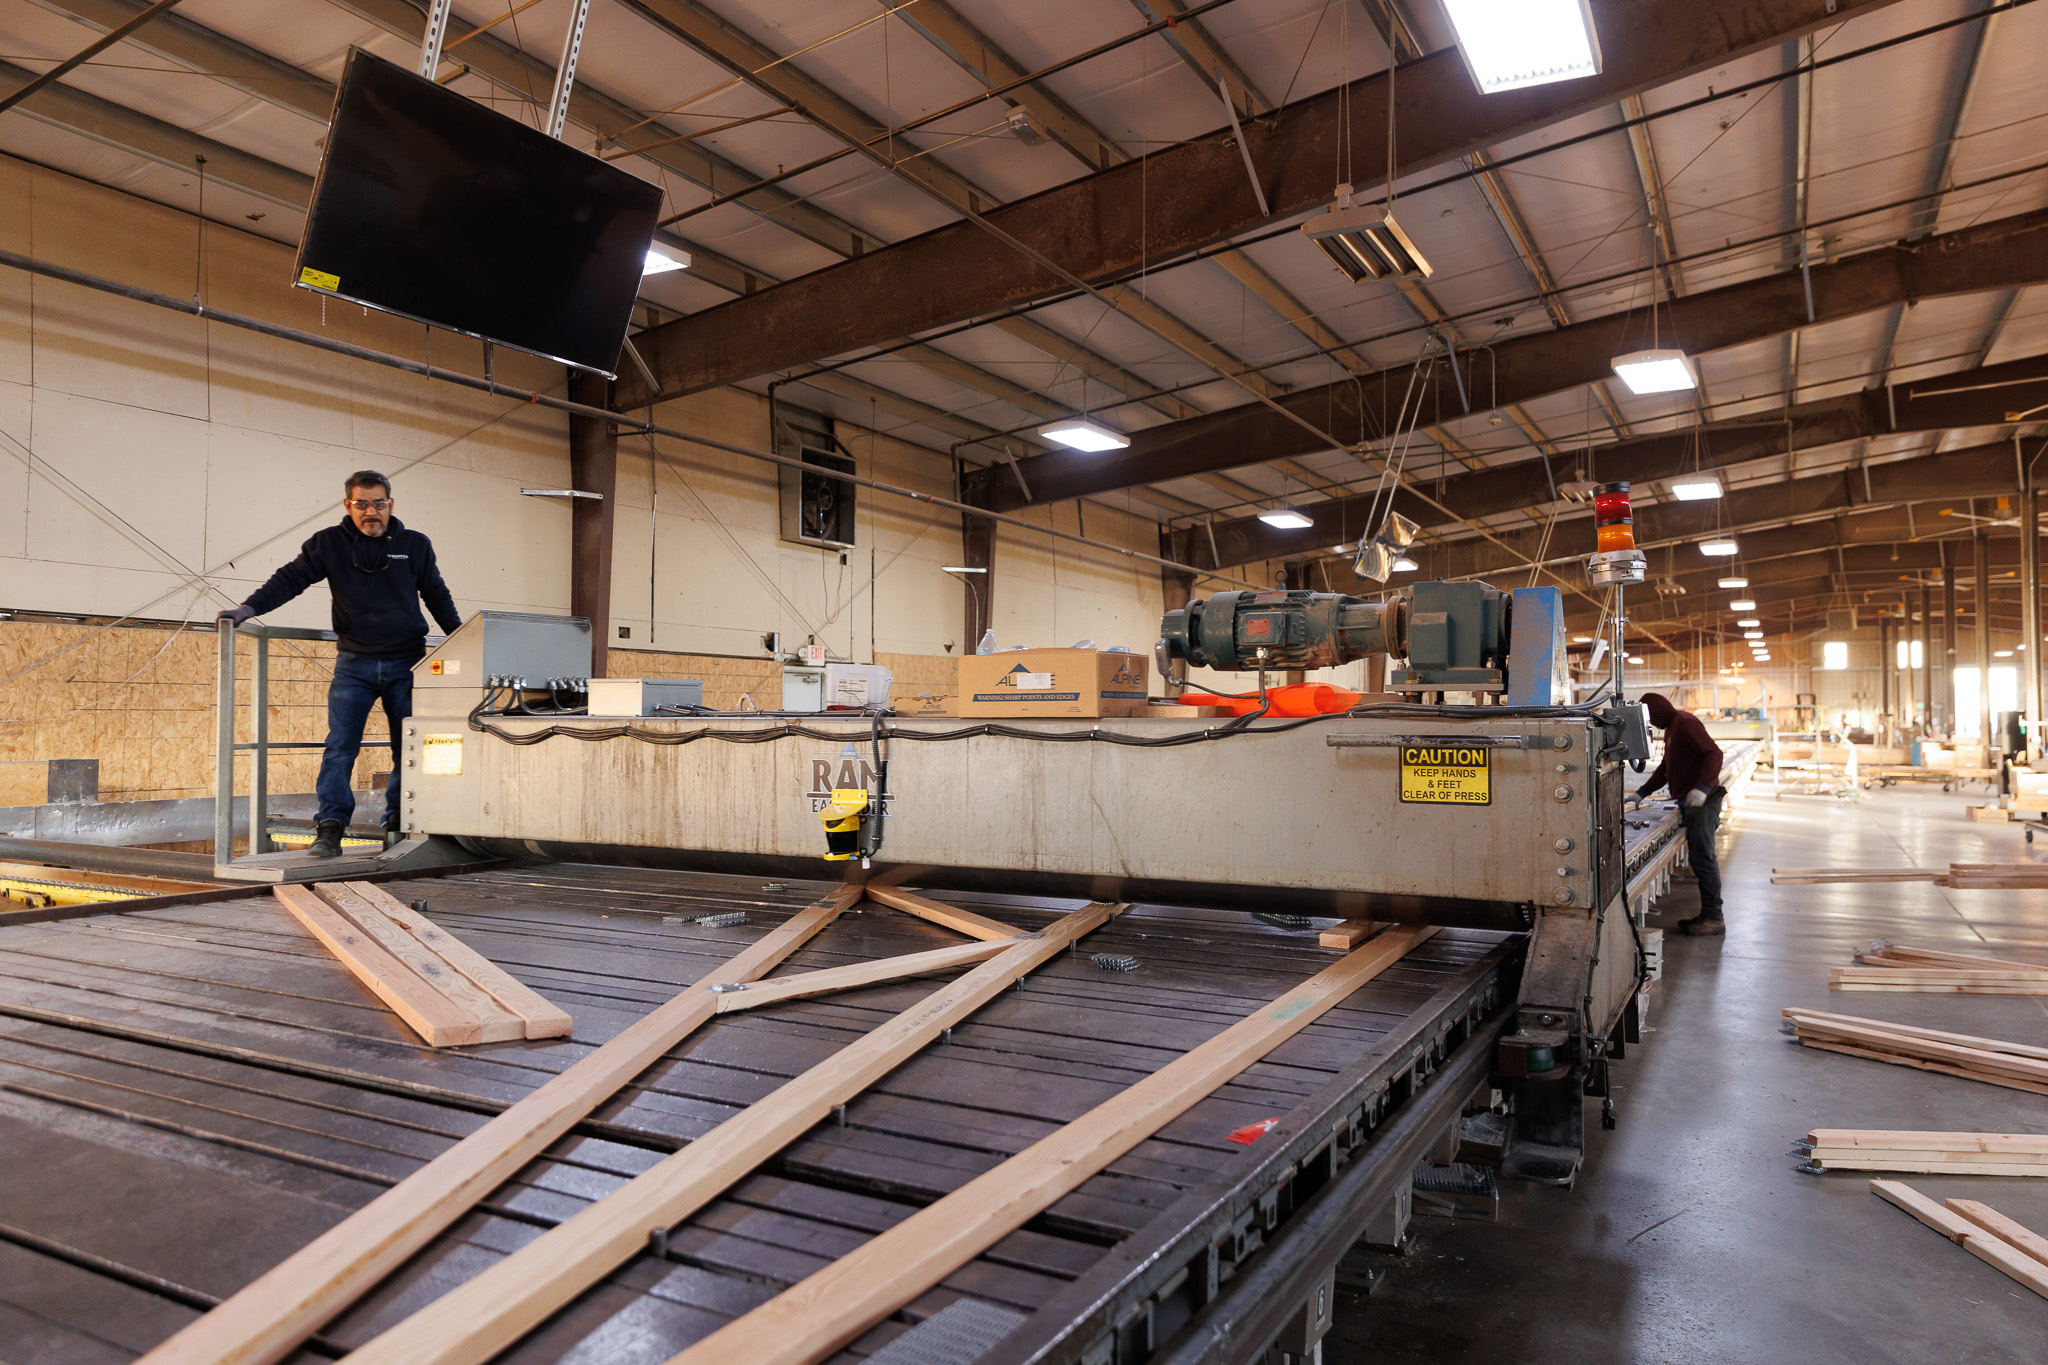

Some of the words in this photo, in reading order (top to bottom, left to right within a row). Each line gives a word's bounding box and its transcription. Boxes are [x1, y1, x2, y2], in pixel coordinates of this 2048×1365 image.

[811, 646, 822, 659] EXIT
[1110, 673, 1140, 684] ALPINE
[1405, 748, 1484, 765] CAUTION
[1413, 768, 1439, 777] KEEP
[1442, 769, 1476, 778] HANDS
[1427, 780, 1434, 788] &
[1437, 780, 1462, 788] FEET
[1403, 790, 1436, 799] CLEAR
[1438, 791, 1451, 800] OF
[1454, 792, 1487, 801] PRESS
